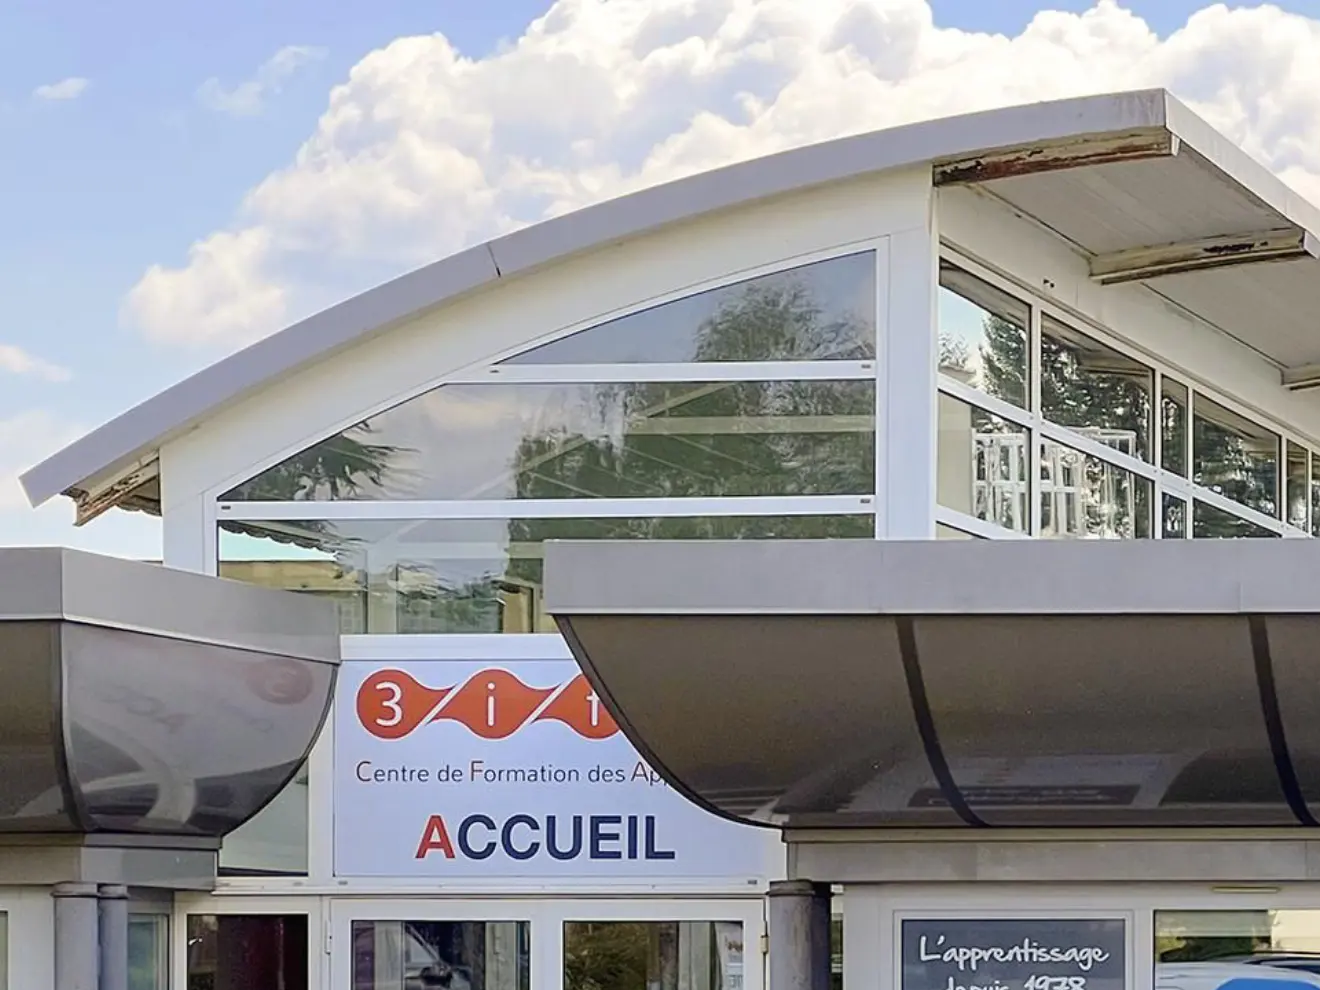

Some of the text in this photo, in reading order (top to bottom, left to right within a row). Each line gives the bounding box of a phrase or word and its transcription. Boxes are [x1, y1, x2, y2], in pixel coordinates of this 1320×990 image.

[356, 760, 429, 782] Centre
[437, 761, 463, 782] de
[470, 760, 580, 782] Formation
[588, 762, 626, 782] des
[415, 814, 675, 860] ACCUEIL
[919, 935, 1109, 971] L'apprentissage
